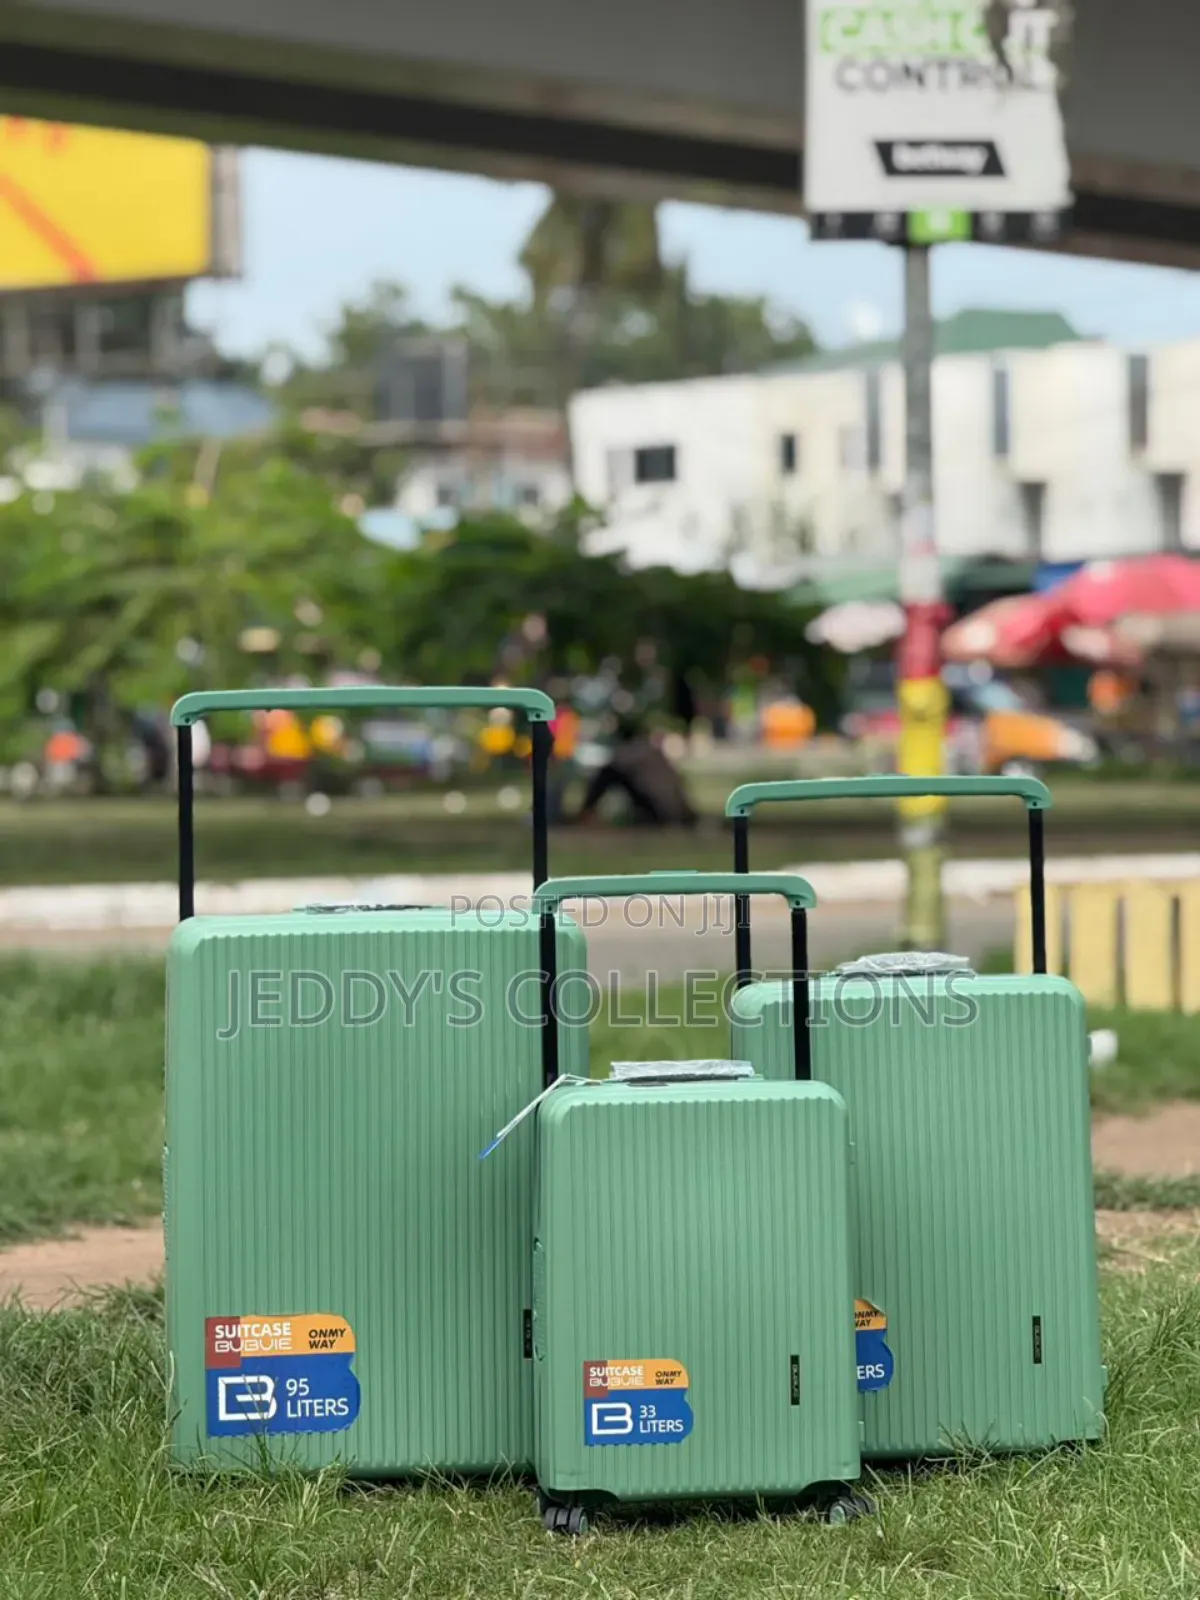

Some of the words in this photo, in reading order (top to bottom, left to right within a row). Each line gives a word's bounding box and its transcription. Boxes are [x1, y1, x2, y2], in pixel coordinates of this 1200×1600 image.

[215, 1322, 291, 1338] SUITCASE
[308, 1328, 347, 1338] ONMY
[308, 1339, 336, 1350] WAY
[589, 1366, 644, 1377] SUITCASE
[285, 1378, 310, 1396] 95
[655, 1378, 676, 1386] WAY
[287, 1397, 350, 1418] LITERS
[639, 1404, 657, 1419] 33
[640, 1419, 684, 1433] LITERS
